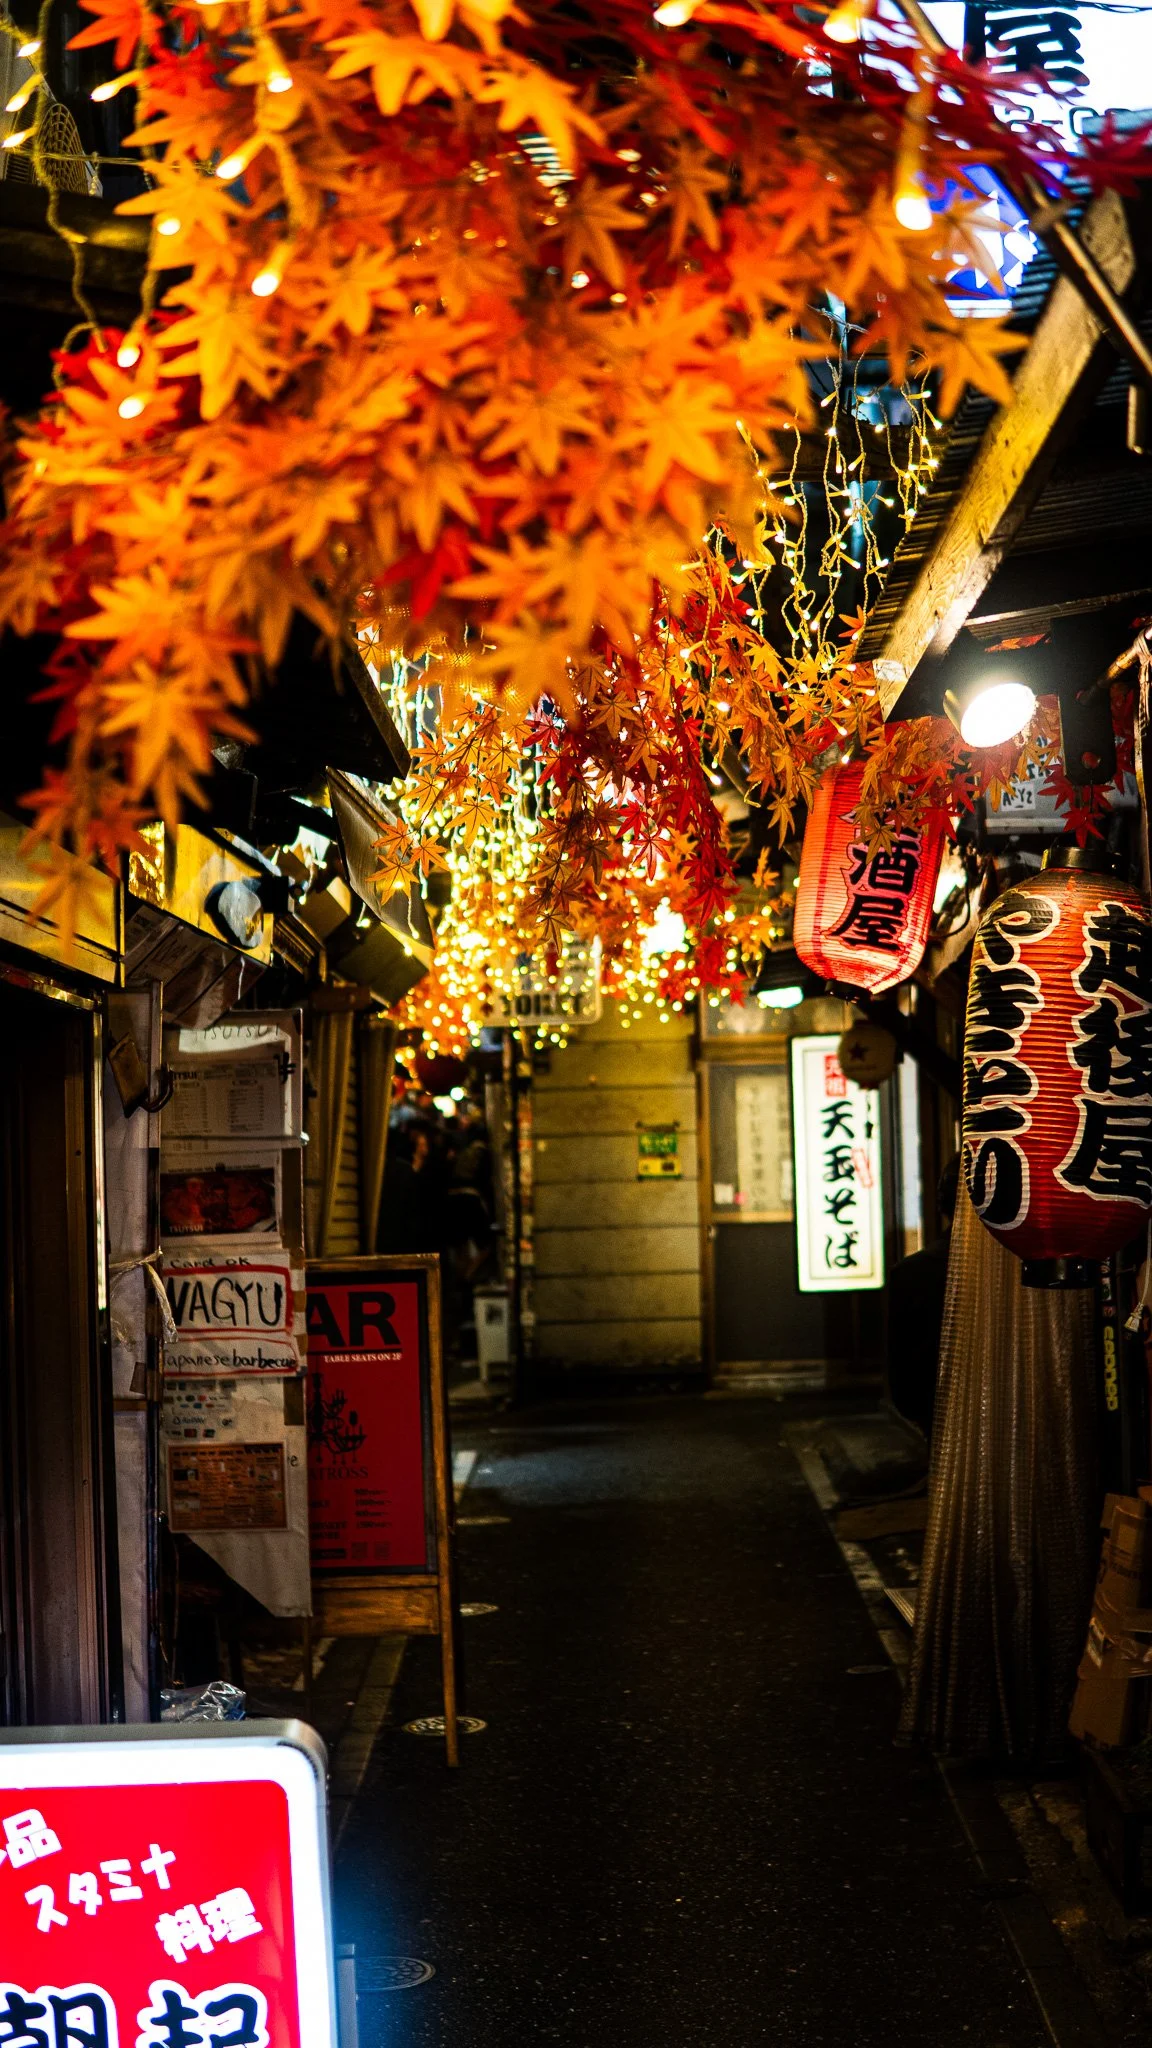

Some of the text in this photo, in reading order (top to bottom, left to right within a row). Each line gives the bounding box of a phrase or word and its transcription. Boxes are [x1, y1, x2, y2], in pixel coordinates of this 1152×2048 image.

[820, 1099, 859, 1269] 天玉そば
[377, 1352, 391, 1361] ON
[24, 1843, 176, 1933] スタミナ
[154, 1887, 263, 1964] 料理
